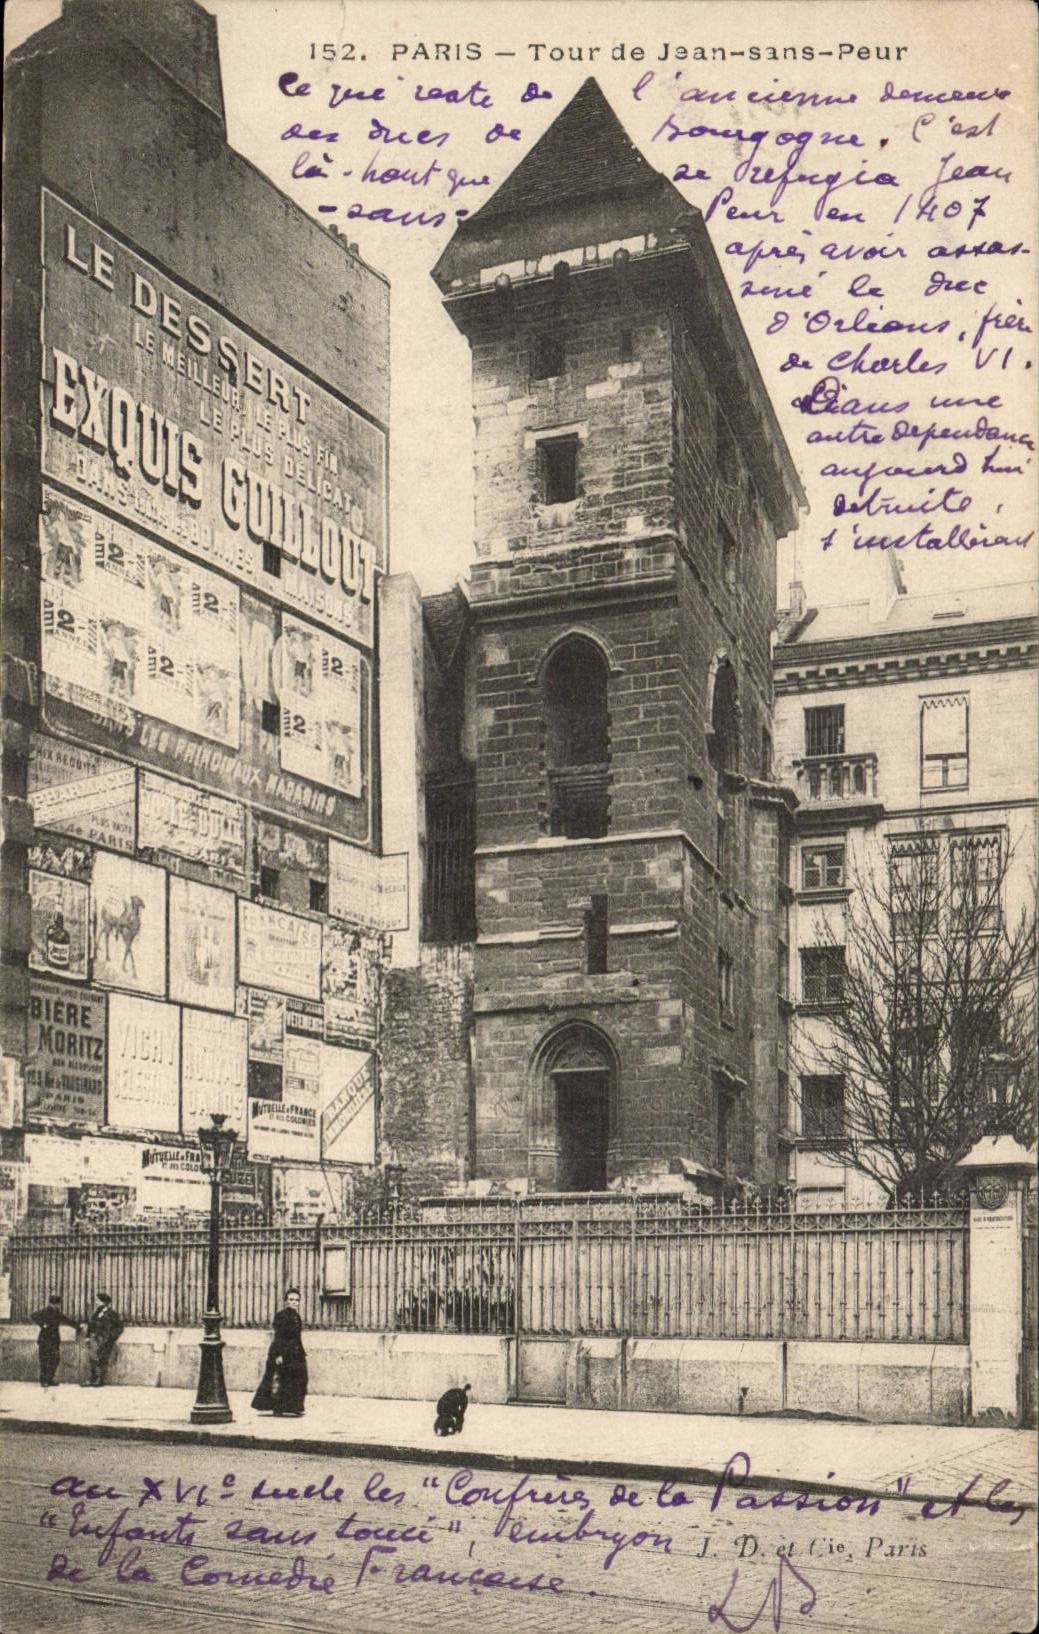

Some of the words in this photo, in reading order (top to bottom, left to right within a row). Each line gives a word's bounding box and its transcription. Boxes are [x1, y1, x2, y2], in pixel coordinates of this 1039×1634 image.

[65, 224, 115, 293] LE
[130, 271, 311, 426] DESSERT
[134, 318, 154, 355] LE
[199, 399, 223, 435] LE
[231, 417, 274, 467] PLUS
[51, 346, 203, 510] EXQUIS
[221, 456, 378, 605] GUILLOUT
[89, 826, 133, 851] PARIS
[39, 1023, 105, 1061] MORITZ
[290, 1104, 317, 1118] FRANCE
[222, 1173, 252, 1186] SUZE
